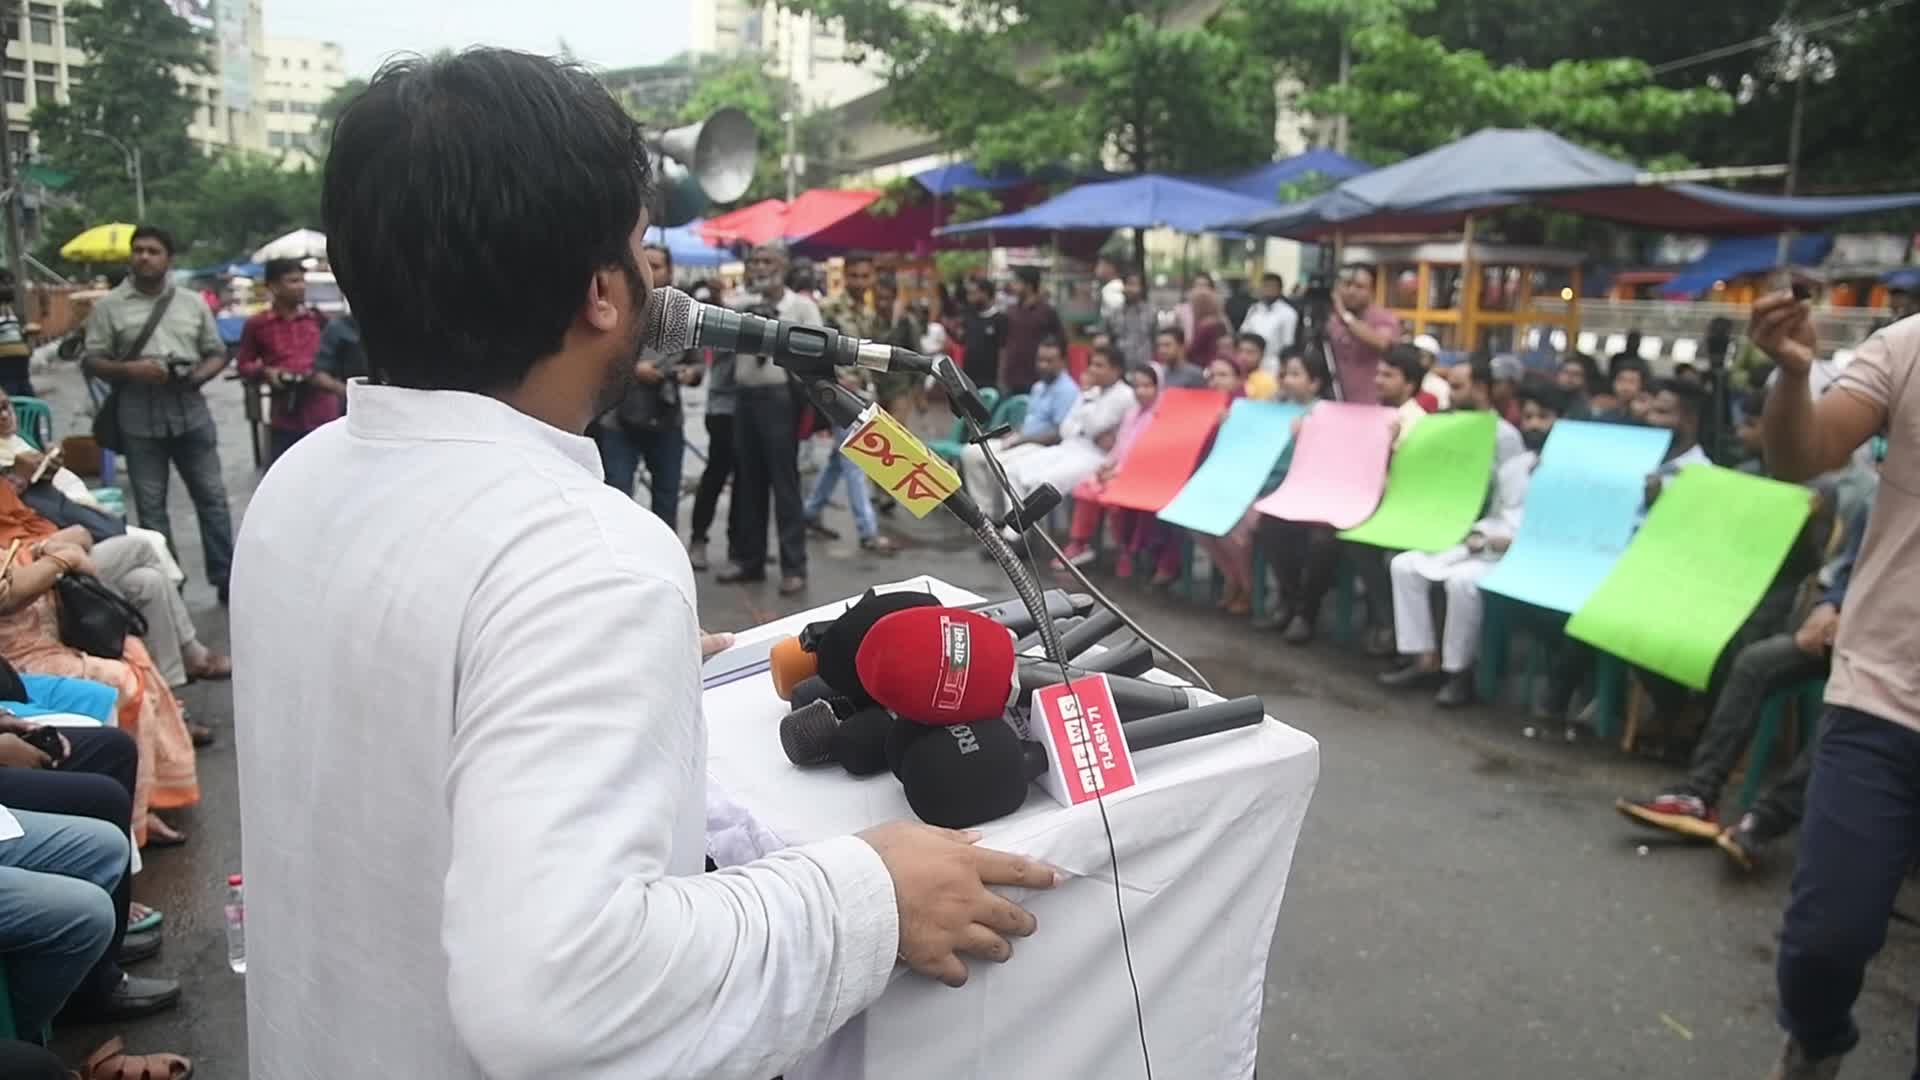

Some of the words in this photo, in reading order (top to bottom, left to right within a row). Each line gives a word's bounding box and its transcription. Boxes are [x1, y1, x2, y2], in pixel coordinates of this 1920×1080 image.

[953, 626, 965, 664] বাংলা
[1087, 706, 1102, 723] 71
[1092, 722, 1116, 769] FLASH
